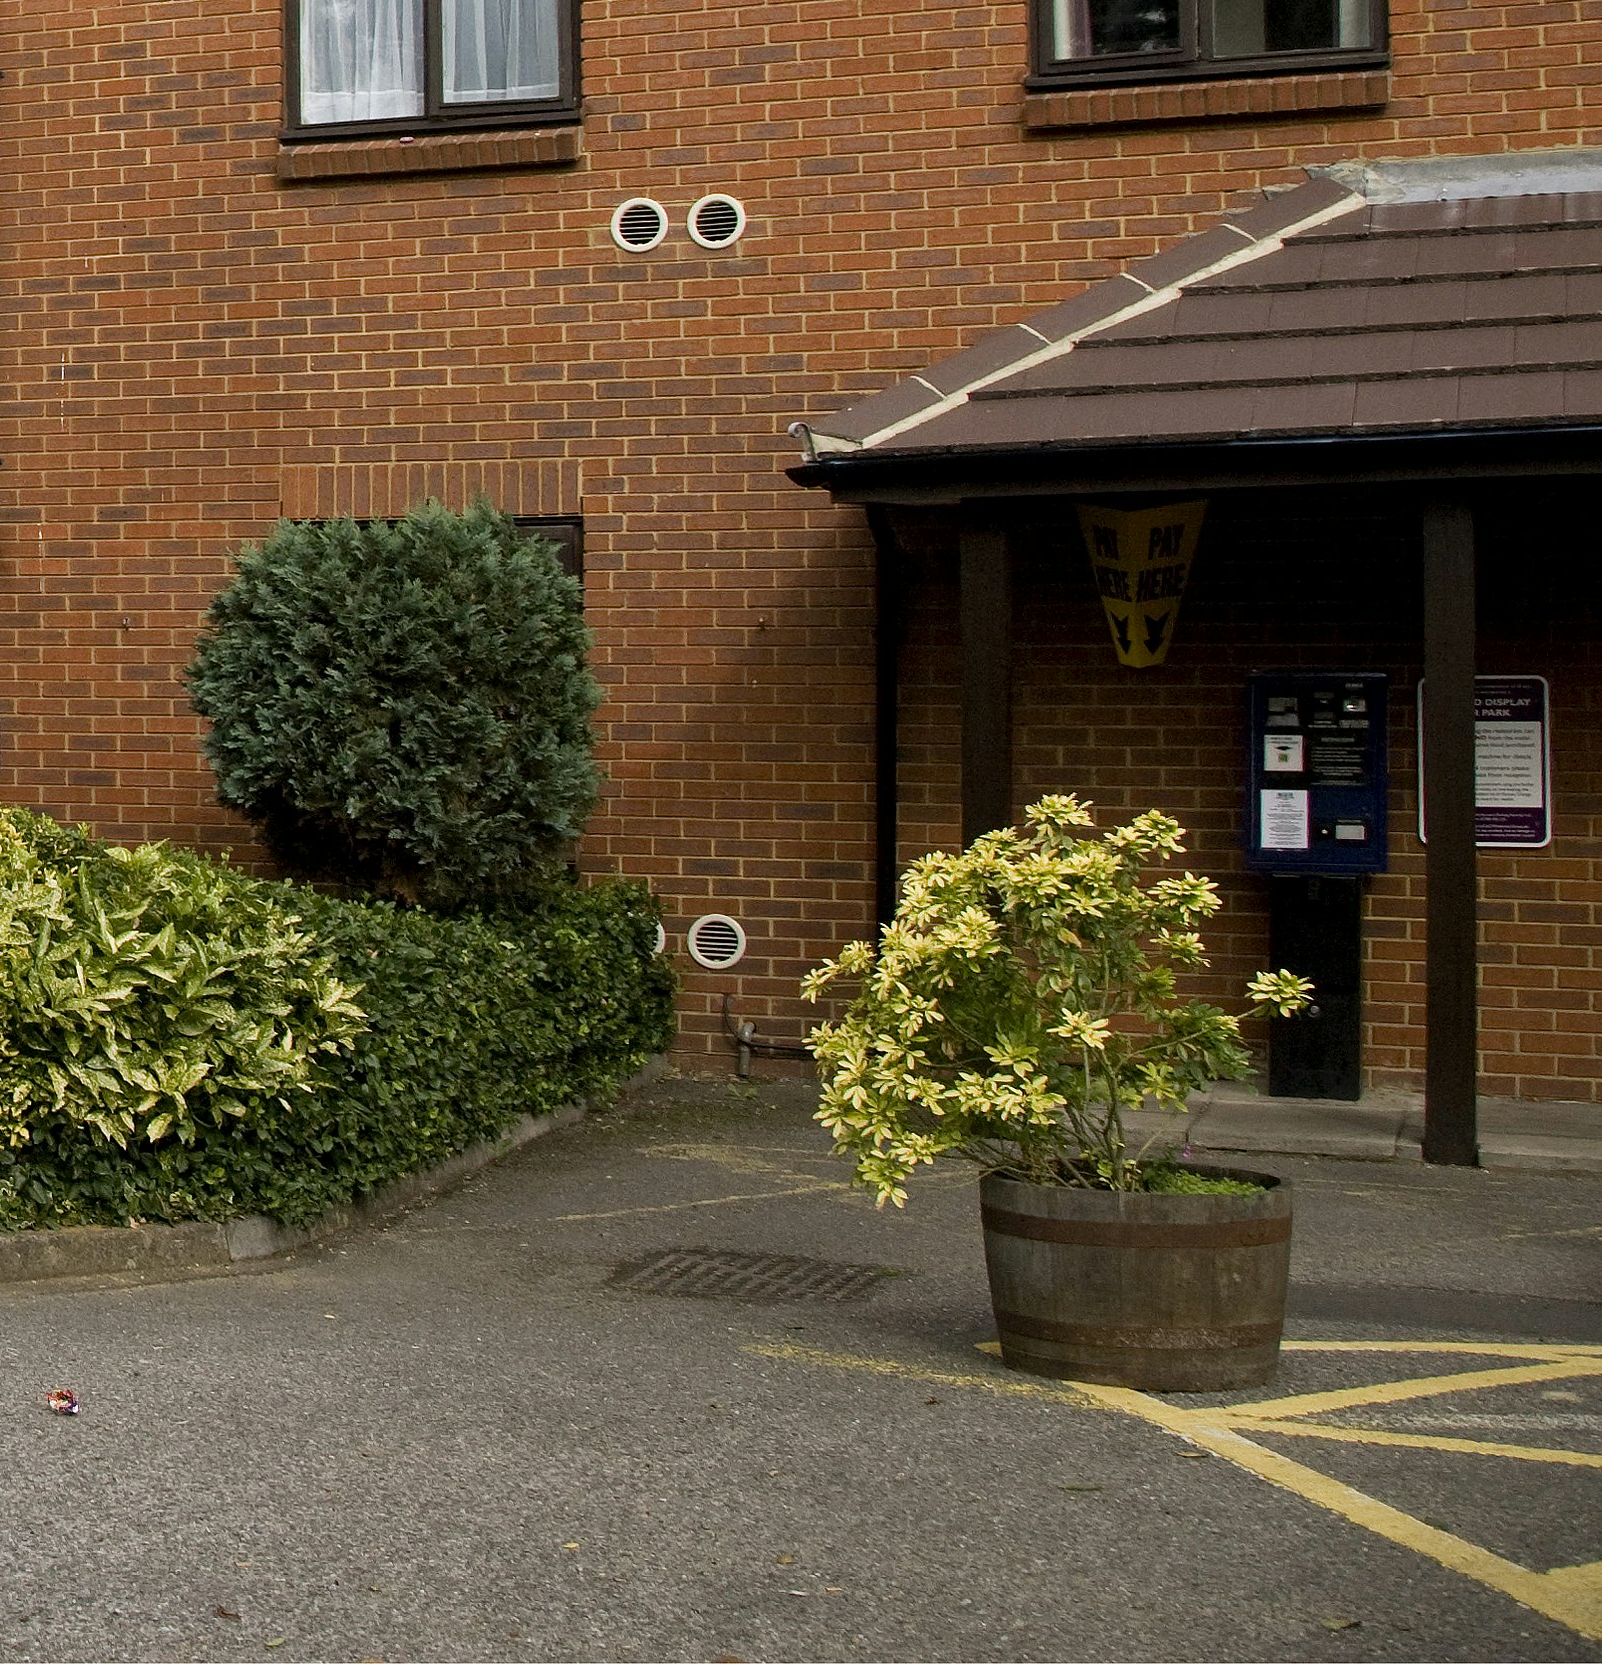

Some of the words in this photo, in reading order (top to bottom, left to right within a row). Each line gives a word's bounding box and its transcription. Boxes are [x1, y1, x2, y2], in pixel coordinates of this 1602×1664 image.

[1148, 523, 1186, 561] PAY
[1136, 562, 1187, 603] HERE
[1481, 708, 1511, 717] PARK
[1485, 698, 1531, 706] DISPLAY
